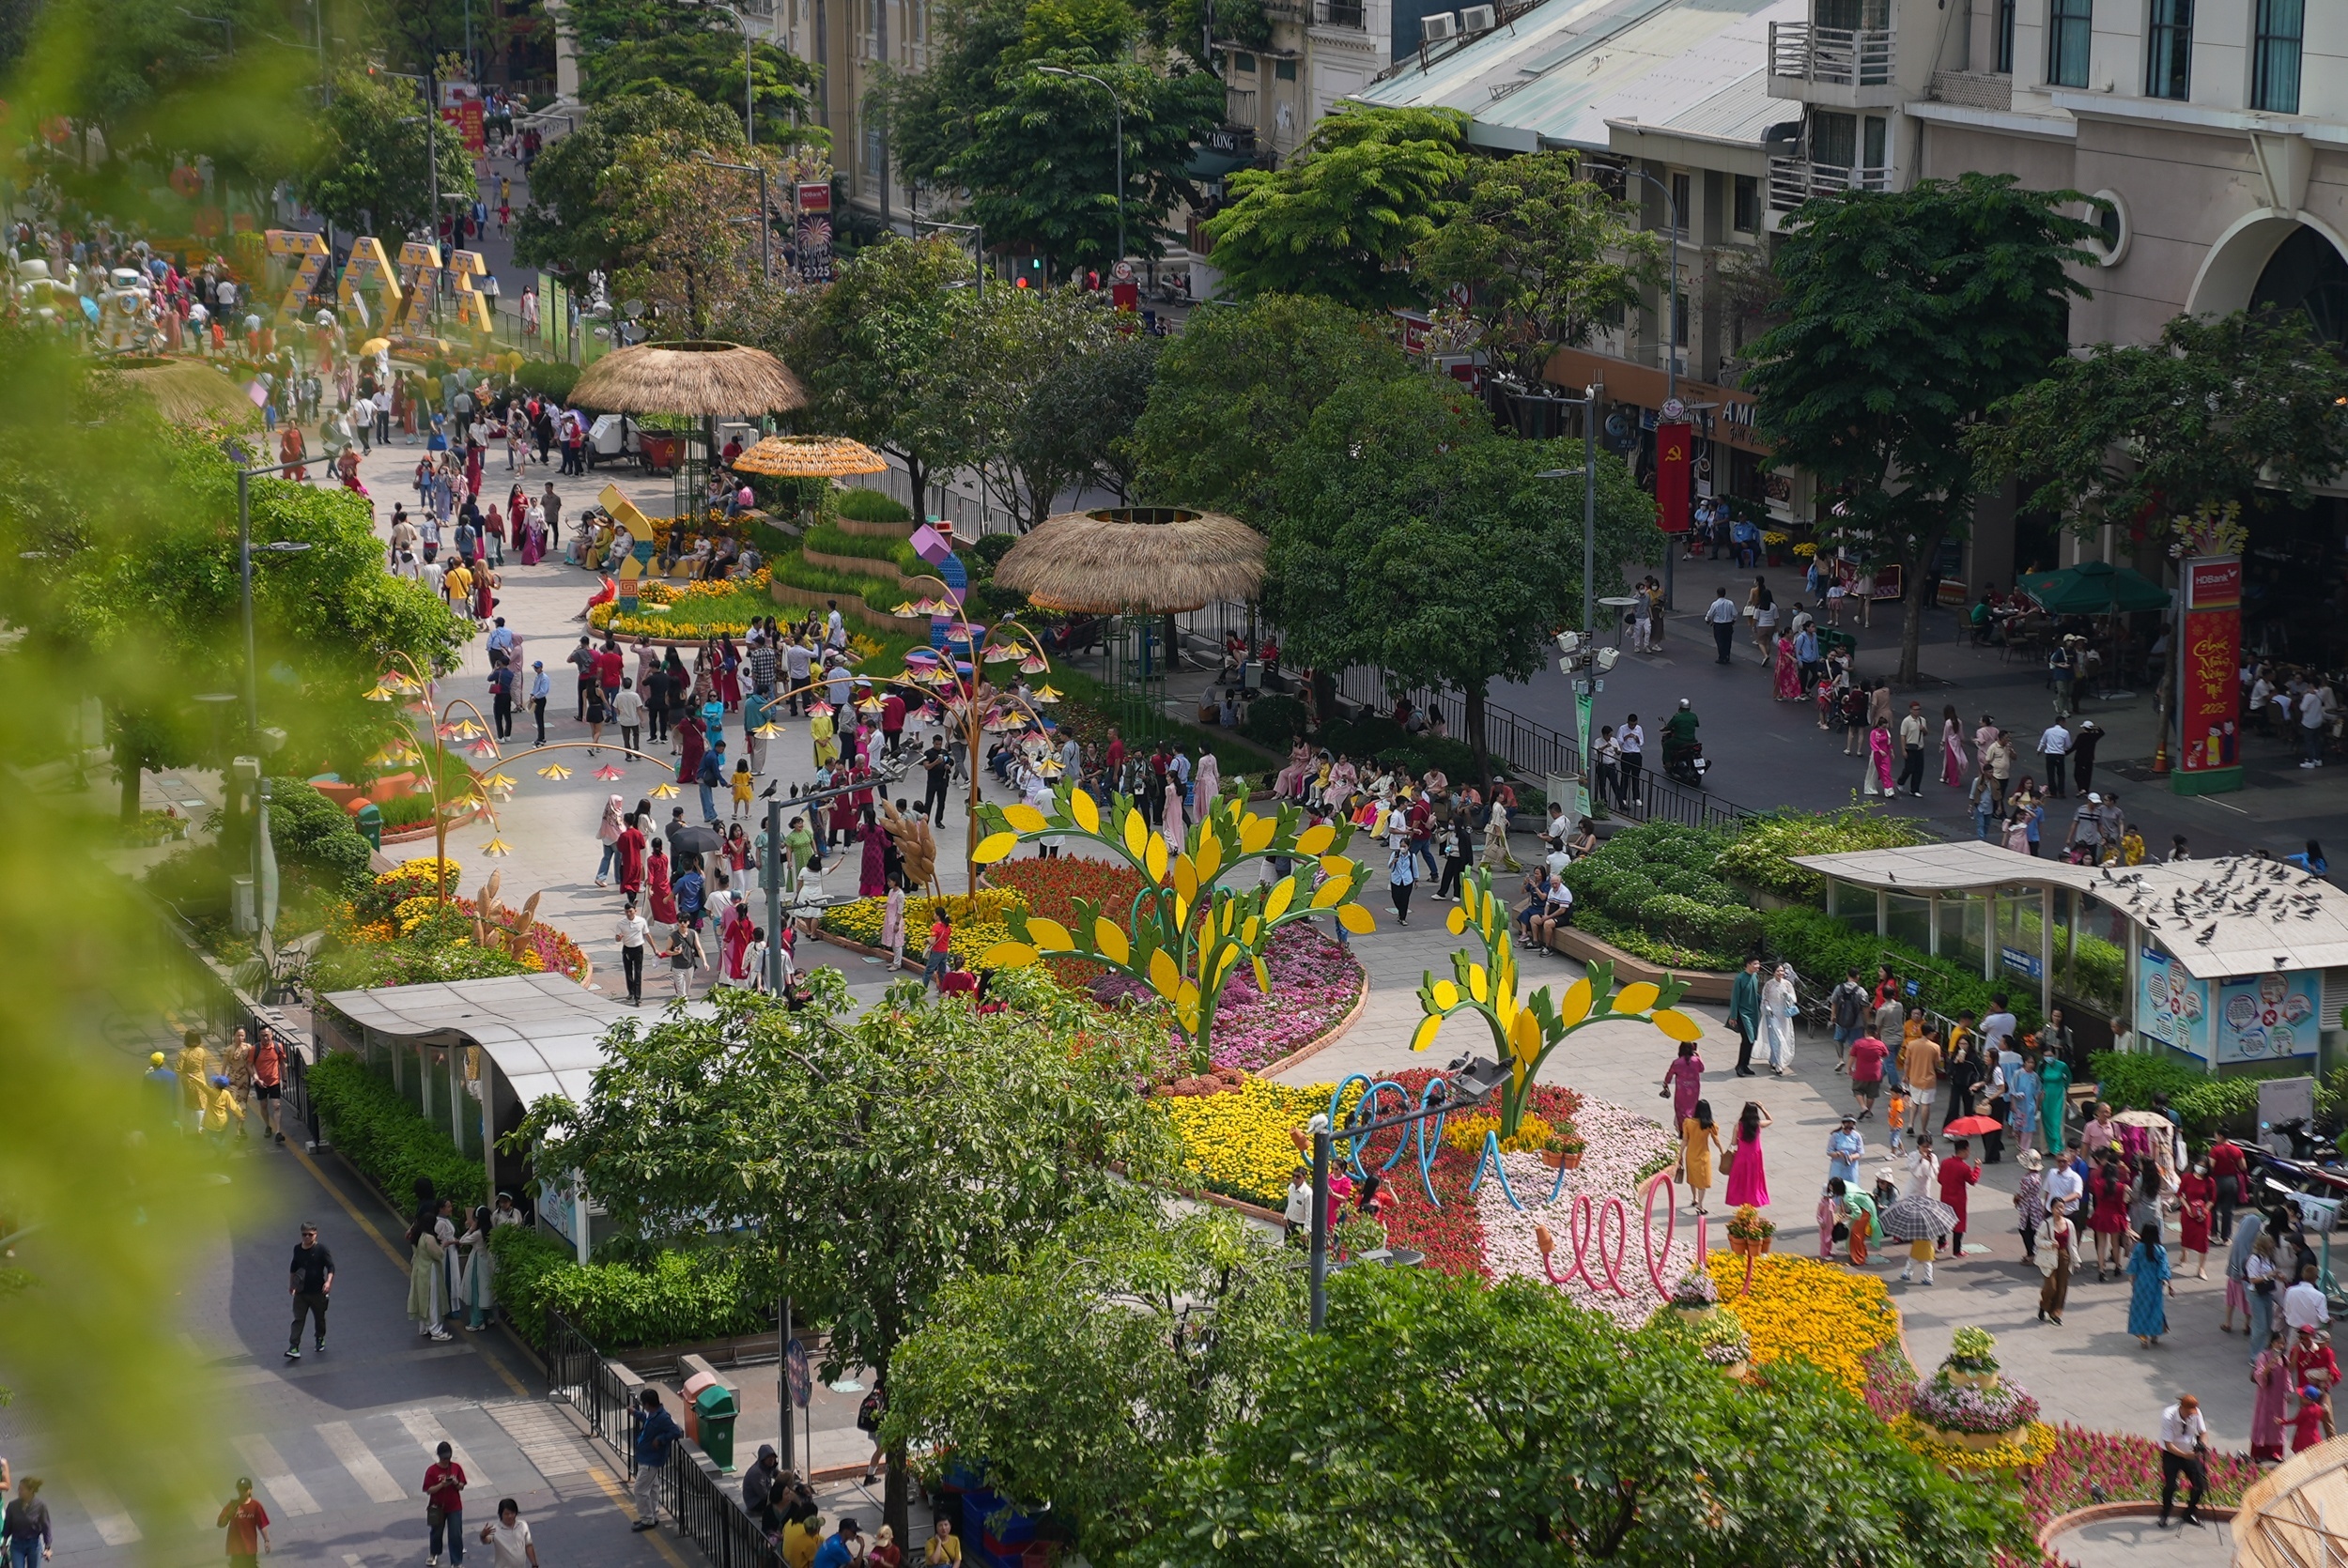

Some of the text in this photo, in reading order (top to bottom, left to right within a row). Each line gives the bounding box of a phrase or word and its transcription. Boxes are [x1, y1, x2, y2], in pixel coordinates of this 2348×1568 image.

[1722, 399, 1756, 427] AMI
[2196, 574, 2229, 584] HDBank
[2200, 701, 2228, 715] 2025
